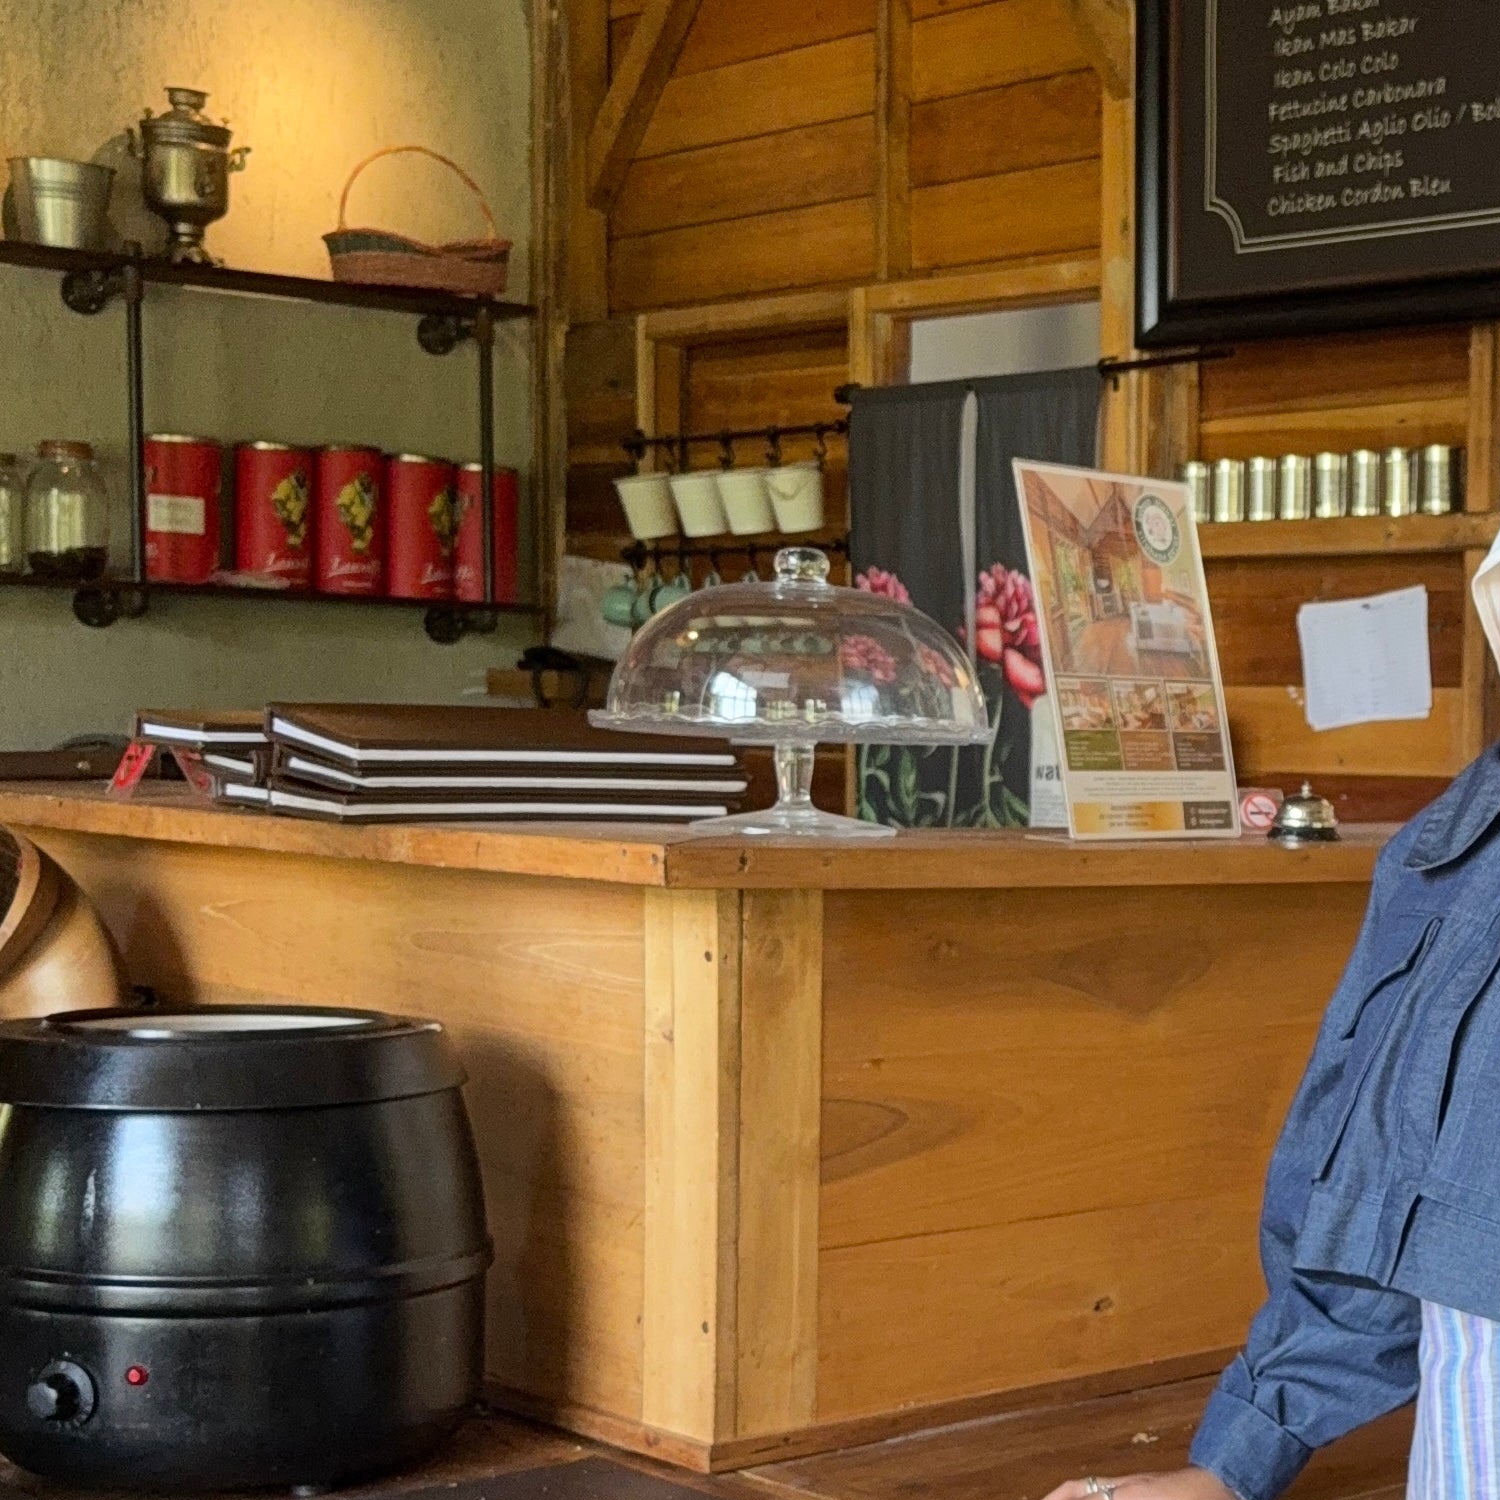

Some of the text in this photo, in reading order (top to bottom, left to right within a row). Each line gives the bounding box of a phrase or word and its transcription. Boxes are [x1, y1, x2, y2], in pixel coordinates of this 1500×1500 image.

[1268, 5, 1322, 34] Ayam
[1274, 17, 1419, 57] Ikan Mas Bakar
[1274, 52, 1399, 89] Ikan Colo Colo
[1352, 77, 1447, 108] Carbonara
[1267, 121, 1352, 157] Spaghetti
[1356, 114, 1407, 144] Aglio
[1411, 106, 1452, 132] Olio
[1273, 148, 1404, 184] Fish and Chips
[1267, 175, 1452, 217] Chicken Cordon Bleu
